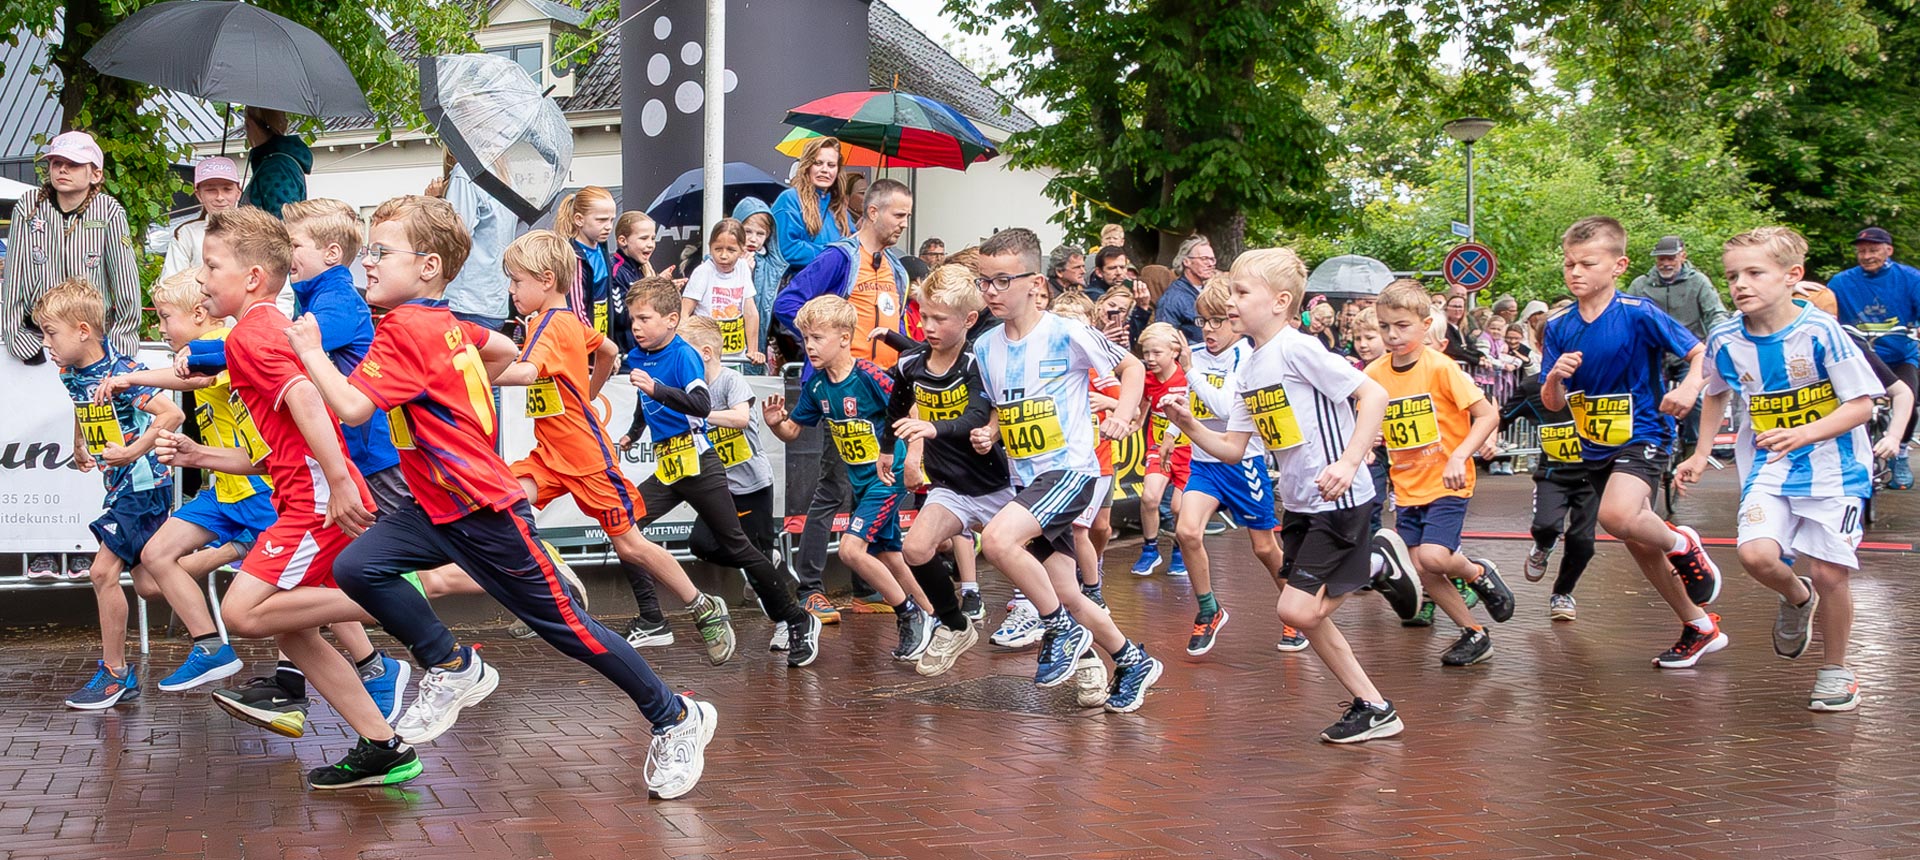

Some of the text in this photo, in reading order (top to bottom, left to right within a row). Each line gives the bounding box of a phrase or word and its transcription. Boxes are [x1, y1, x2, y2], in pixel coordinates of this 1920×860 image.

[916, 383, 968, 407] Step One
[1257, 388, 1286, 407] One
[1597, 397, 1629, 412] One
[1749, 382, 1833, 412] Step One
[88, 404, 113, 418] One
[1022, 399, 1054, 418] One
[1402, 398, 1431, 414] One
[1007, 424, 1046, 454] 440
[1389, 420, 1421, 446] 431
[1541, 426, 1575, 439] Step
[2, 493, 60, 505] 35 25 00
[601, 507, 621, 527] 10
[1840, 504, 1857, 534] 10
